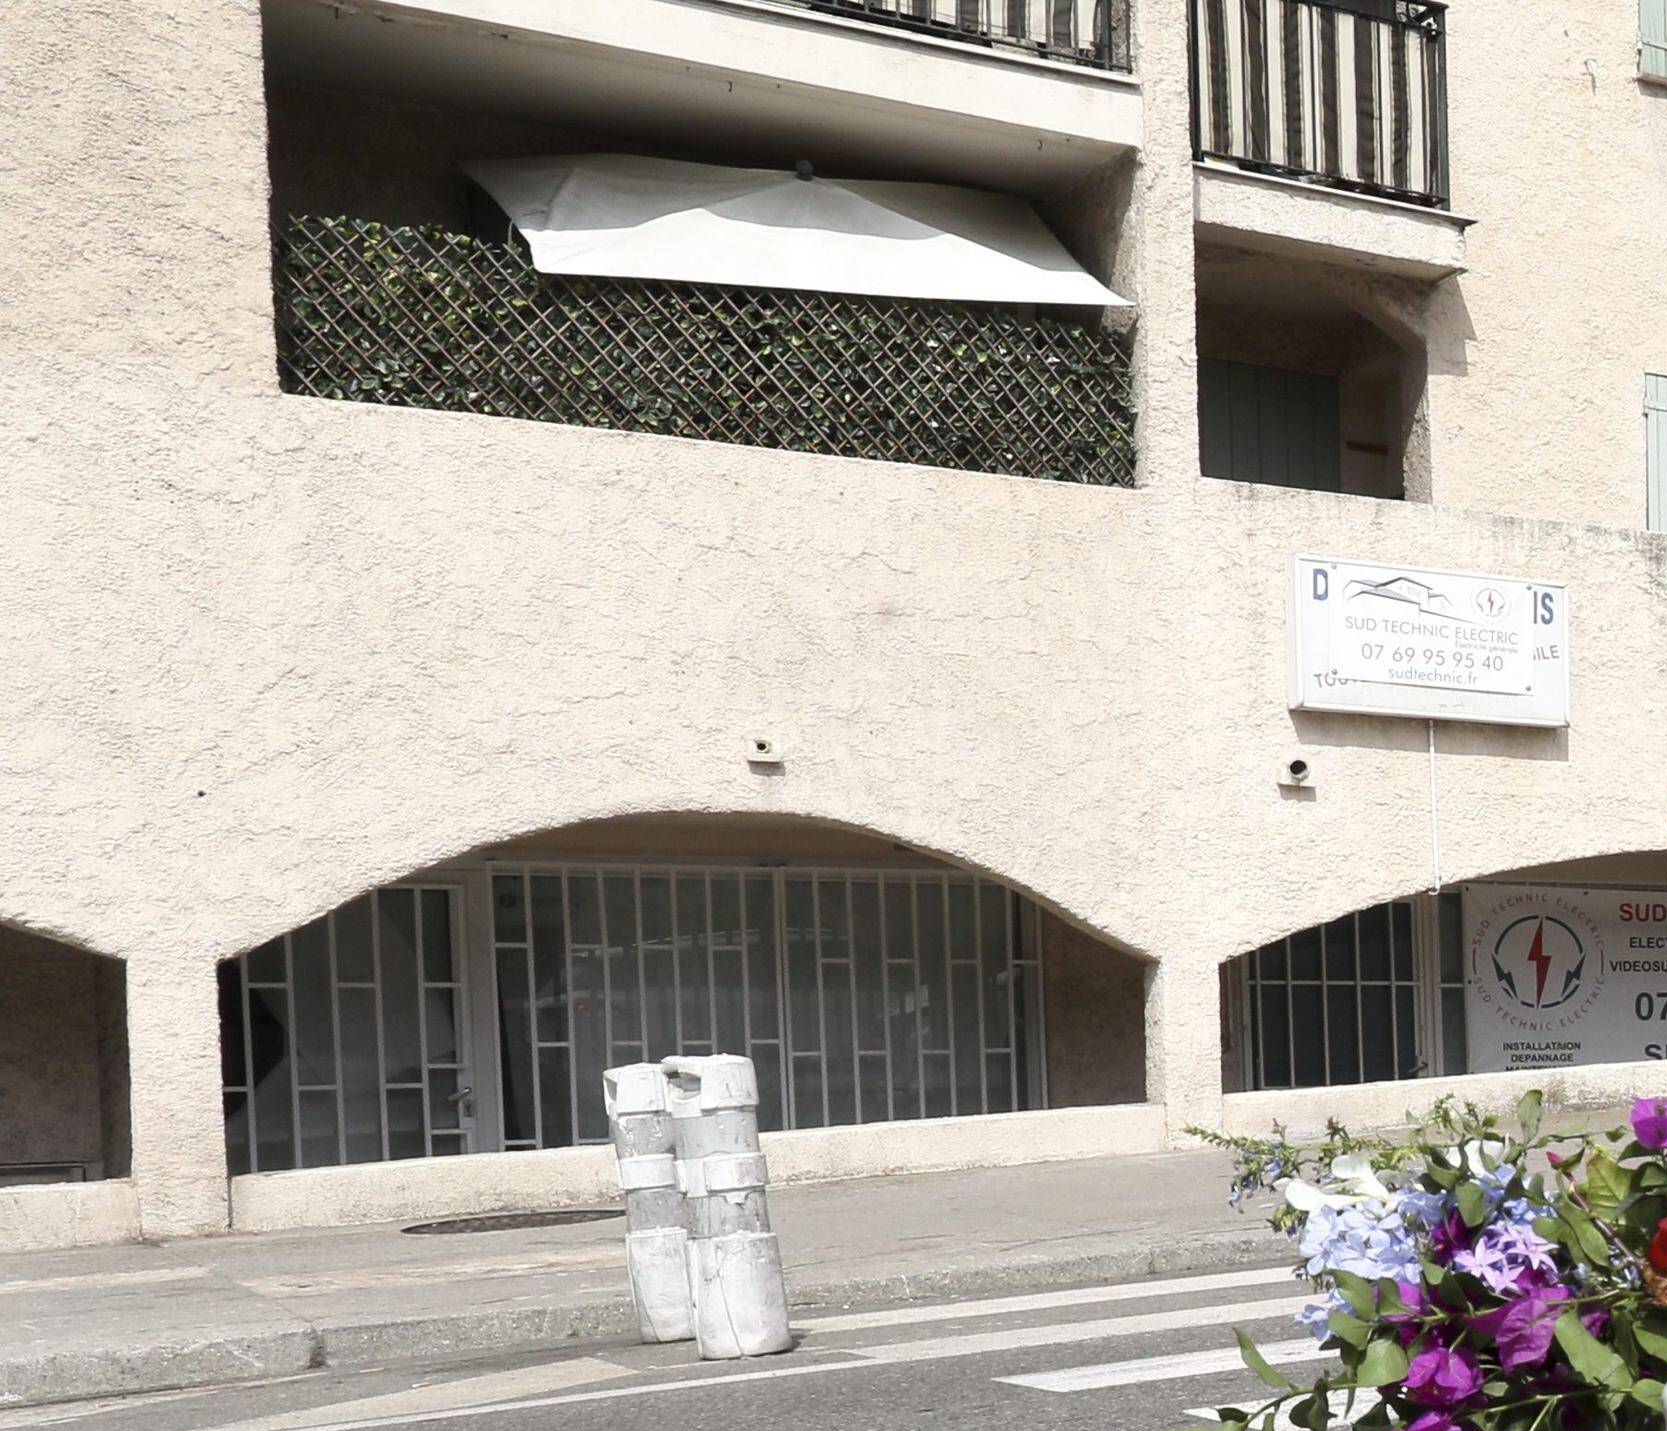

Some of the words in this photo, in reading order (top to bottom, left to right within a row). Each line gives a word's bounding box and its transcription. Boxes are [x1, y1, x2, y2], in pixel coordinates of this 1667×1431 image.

[1345, 615, 1377, 631] SUD
[1382, 619, 1450, 638] TECHNIC
[1455, 626, 1519, 645] ELECTRIC
[1361, 643, 1384, 660] 07
[1392, 646, 1416, 663] 69
[1423, 648, 1446, 666] 95
[1452, 651, 1475, 669] 95
[1482, 655, 1504, 671] 40
[1533, 644, 1560, 661] ILE
[1388, 665, 1479, 685] sudtechnic.fr
[1473, 918, 1491, 946] SUD
[1492, 893, 1549, 916] TECHNIC
[1555, 897, 1604, 946] ELECTRIC
[1619, 903, 1667, 923] SUD
[1473, 976, 1491, 1003] SUD
[1495, 1006, 1552, 1031] TECHNIC
[1559, 977, 1605, 1028] ELECTRIC
[1511, 1053, 1573, 1062] DEPANNAGE
